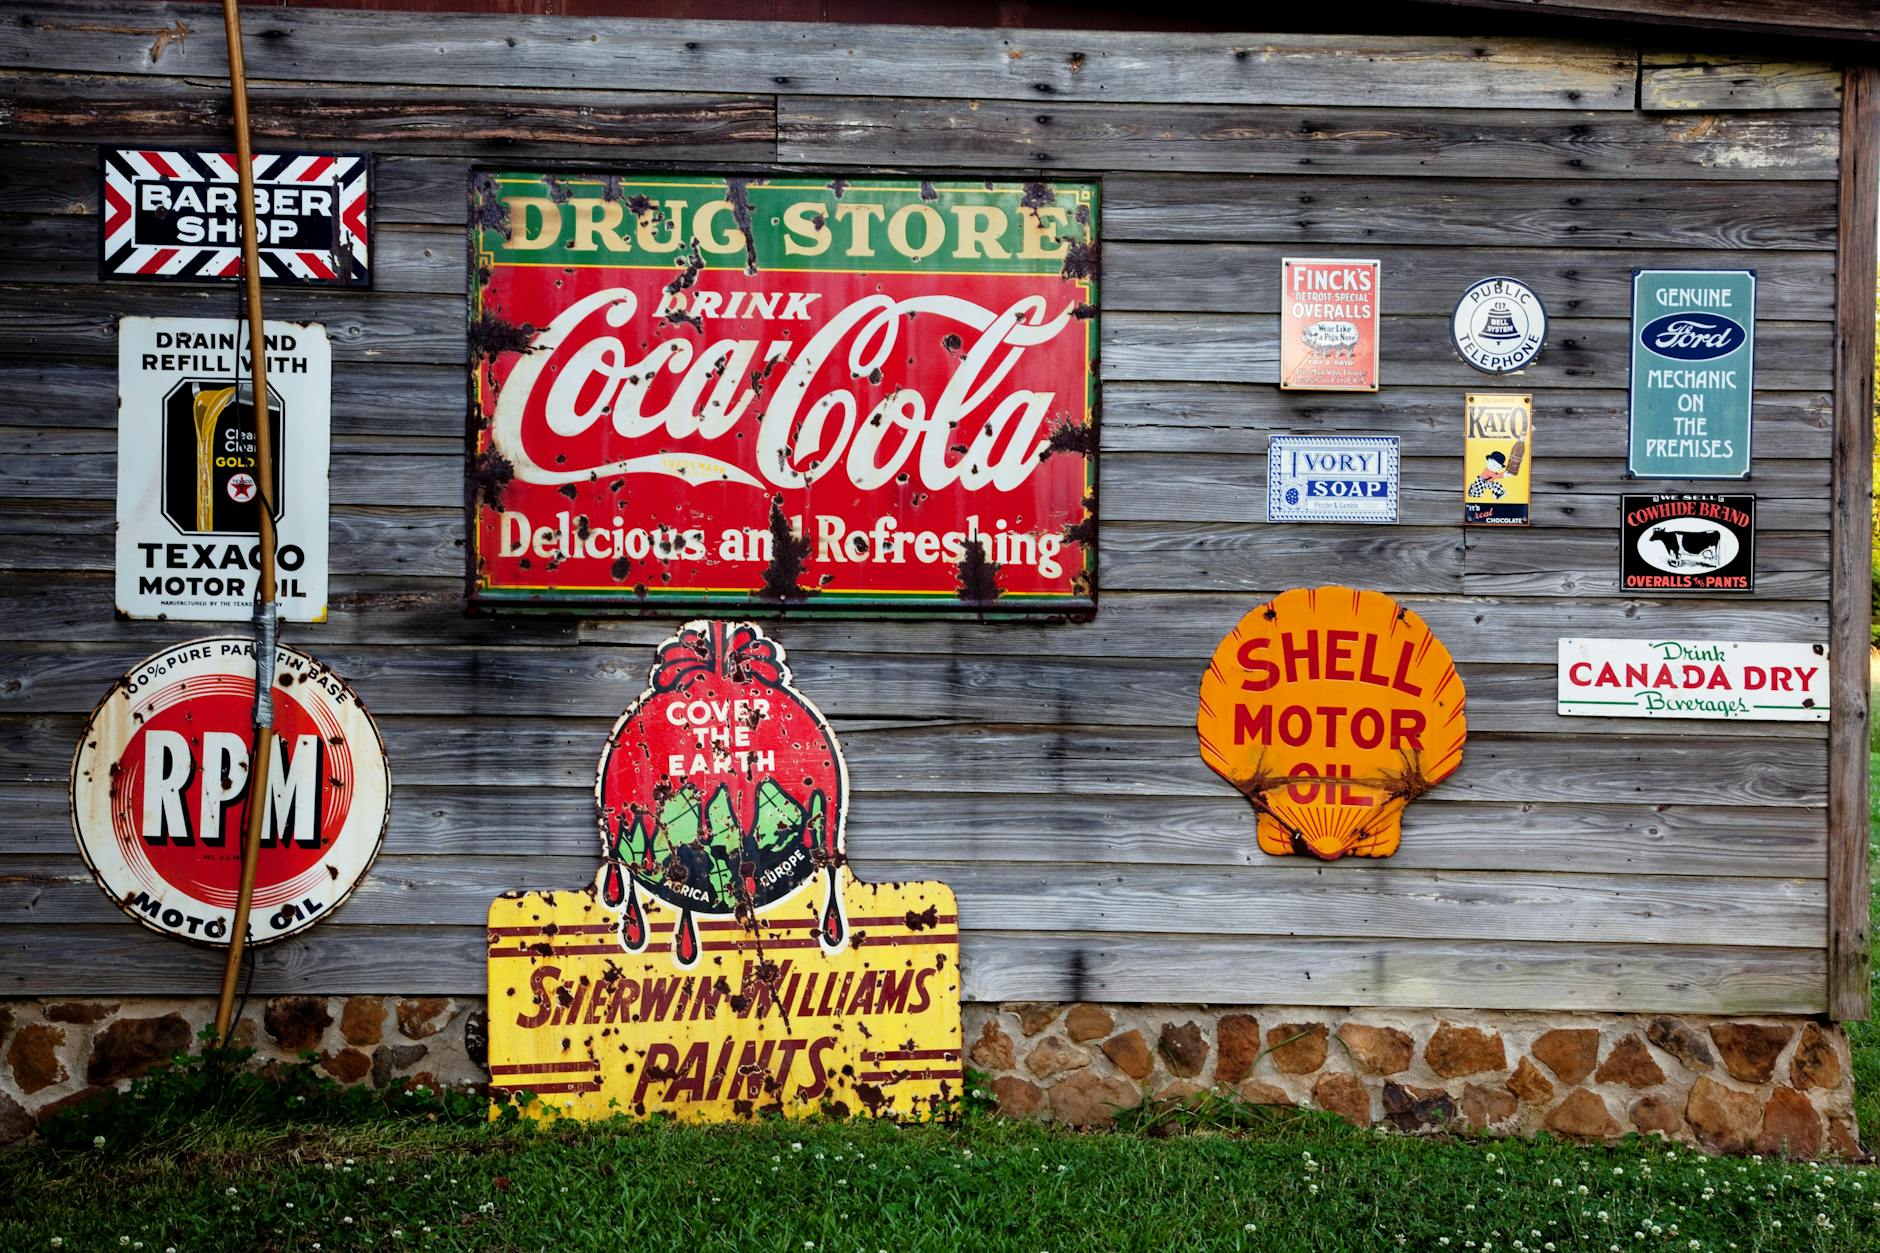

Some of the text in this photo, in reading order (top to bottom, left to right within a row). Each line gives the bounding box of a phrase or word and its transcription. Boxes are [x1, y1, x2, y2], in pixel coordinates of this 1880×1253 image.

[142, 184, 332, 217] BARBER
[501, 198, 1070, 260] DRUG STORE
[1293, 266, 1372, 292] FINCK'S
[652, 291, 822, 319] DRINK
[1470, 283, 1531, 305] PUBLIC
[1655, 288, 1733, 307] GENUINE
[1292, 303, 1372, 320] OVERALLS
[1490, 318, 1509, 326] BELL
[156, 332, 297, 351] DRAIN ND
[1486, 325, 1514, 333] SYSTEM
[1655, 320, 1733, 349] Ford
[142, 354, 231, 372] REFILL
[1459, 333, 1540, 367] TELEPHONE
[493, 287, 1075, 492] Coca-Cola
[1647, 370, 1737, 389] MECHANIC
[1677, 394, 1704, 412] ON
[1467, 405, 1528, 440] KAYO
[1673, 417, 1708, 436] THE
[1646, 439, 1734, 458] PREMISES
[1292, 451, 1374, 478] IVORY
[1312, 481, 1381, 497] SOAP
[1485, 517, 1523, 525] CHOCOLATE
[1626, 501, 1750, 528] COWHIDE BRAND
[498, 510, 706, 561] Delicious
[815, 514, 1065, 579] Refreshing
[139, 576, 307, 598] MOTOR IL
[1626, 575, 1692, 588] OVERALLS
[1706, 576, 1748, 588] PANTS
[1236, 629, 1423, 698] SHELL
[1653, 641, 1726, 662] Drink
[167, 646, 212, 669] PURE
[221, 644, 304, 672] PARFIN
[307, 667, 348, 705] BASE
[1569, 661, 1819, 692] CANADA DRY
[666, 698, 772, 726] COVER
[1634, 690, 1750, 718] Beverages
[692, 727, 751, 748] THE
[1233, 703, 1427, 750] MOTOR
[668, 749, 775, 777] EARTH
[142, 729, 323, 850] RPM
[1286, 762, 1375, 807] OIL
[759, 848, 806, 888] EUROPE
[270, 897, 324, 931] OIL
[516, 959, 937, 1029] SHERWIN-WILLIAMS
[632, 1035, 839, 1104] PAINTS
